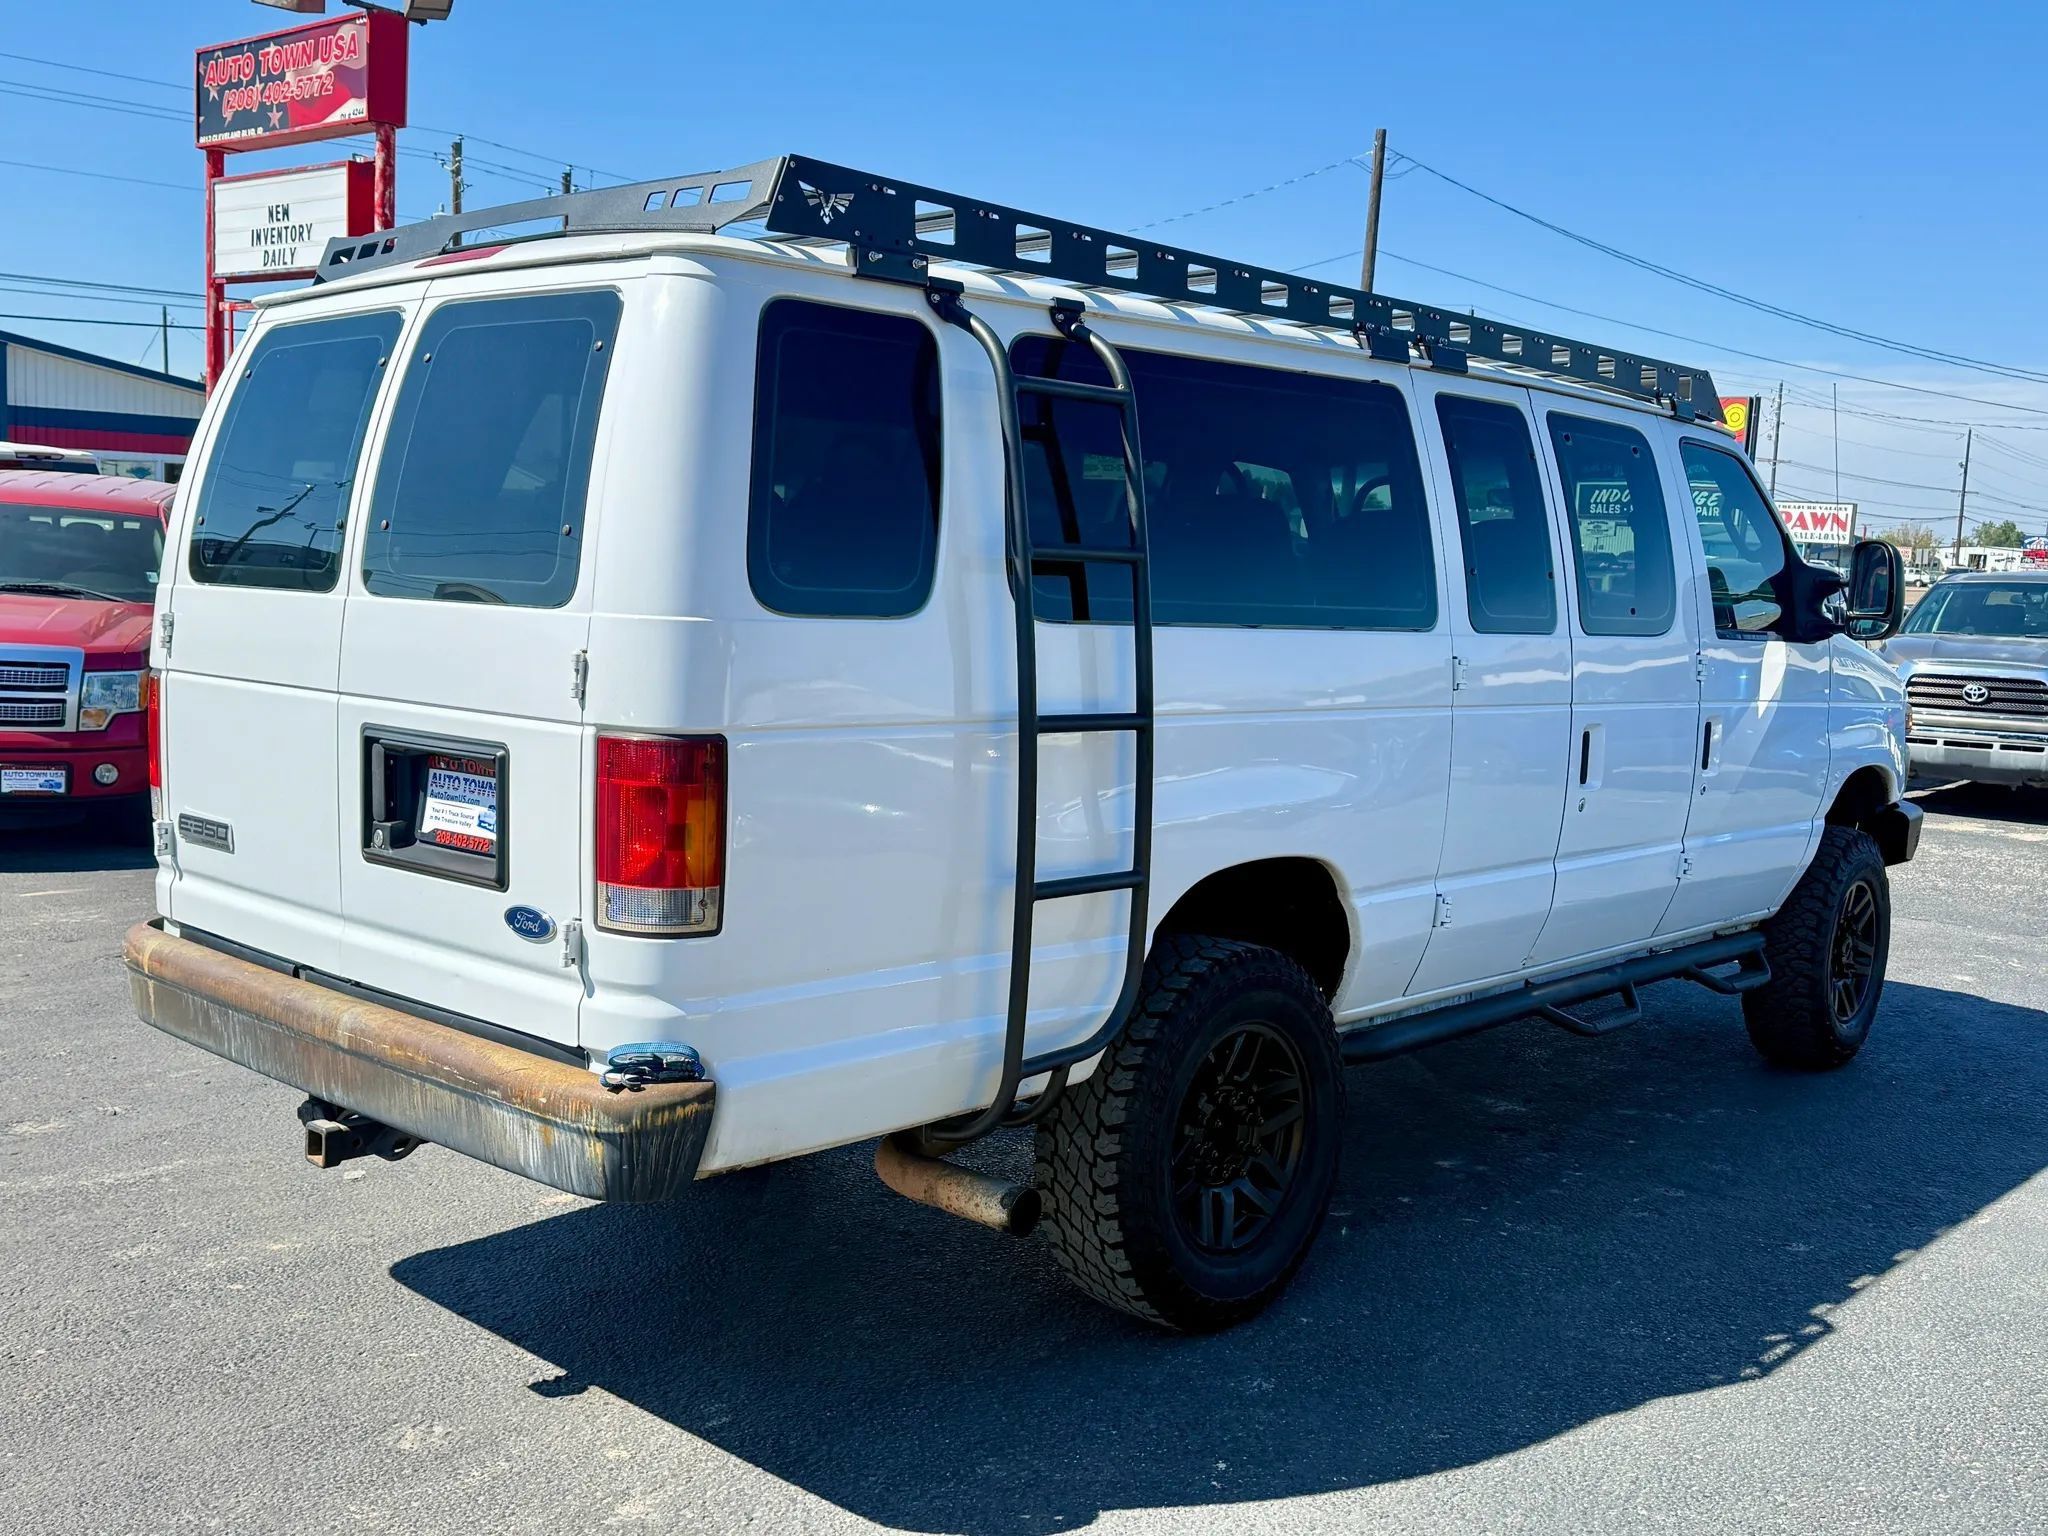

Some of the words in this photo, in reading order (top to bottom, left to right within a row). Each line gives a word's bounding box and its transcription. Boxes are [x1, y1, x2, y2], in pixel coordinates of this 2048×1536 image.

[204, 52, 255, 88] AUTO
[259, 39, 315, 76] TOWN
[319, 31, 359, 65] USA
[222, 86, 259, 118] (208)
[263, 71, 334, 105] 402-5772
[268, 203, 290, 223] NEW
[251, 222, 313, 247] INVENTORY
[263, 247, 297, 267] DAILY
[1590, 503, 1621, 514] SALES
[1780, 511, 1849, 533] PAWN
[430, 772, 461, 792] AUTO
[463, 776, 497, 799] TOWN
[429, 788, 481, 806] AutoTownUS.com
[435, 830, 490, 852] 208-402-5772
[514, 910, 541, 933] Ford
